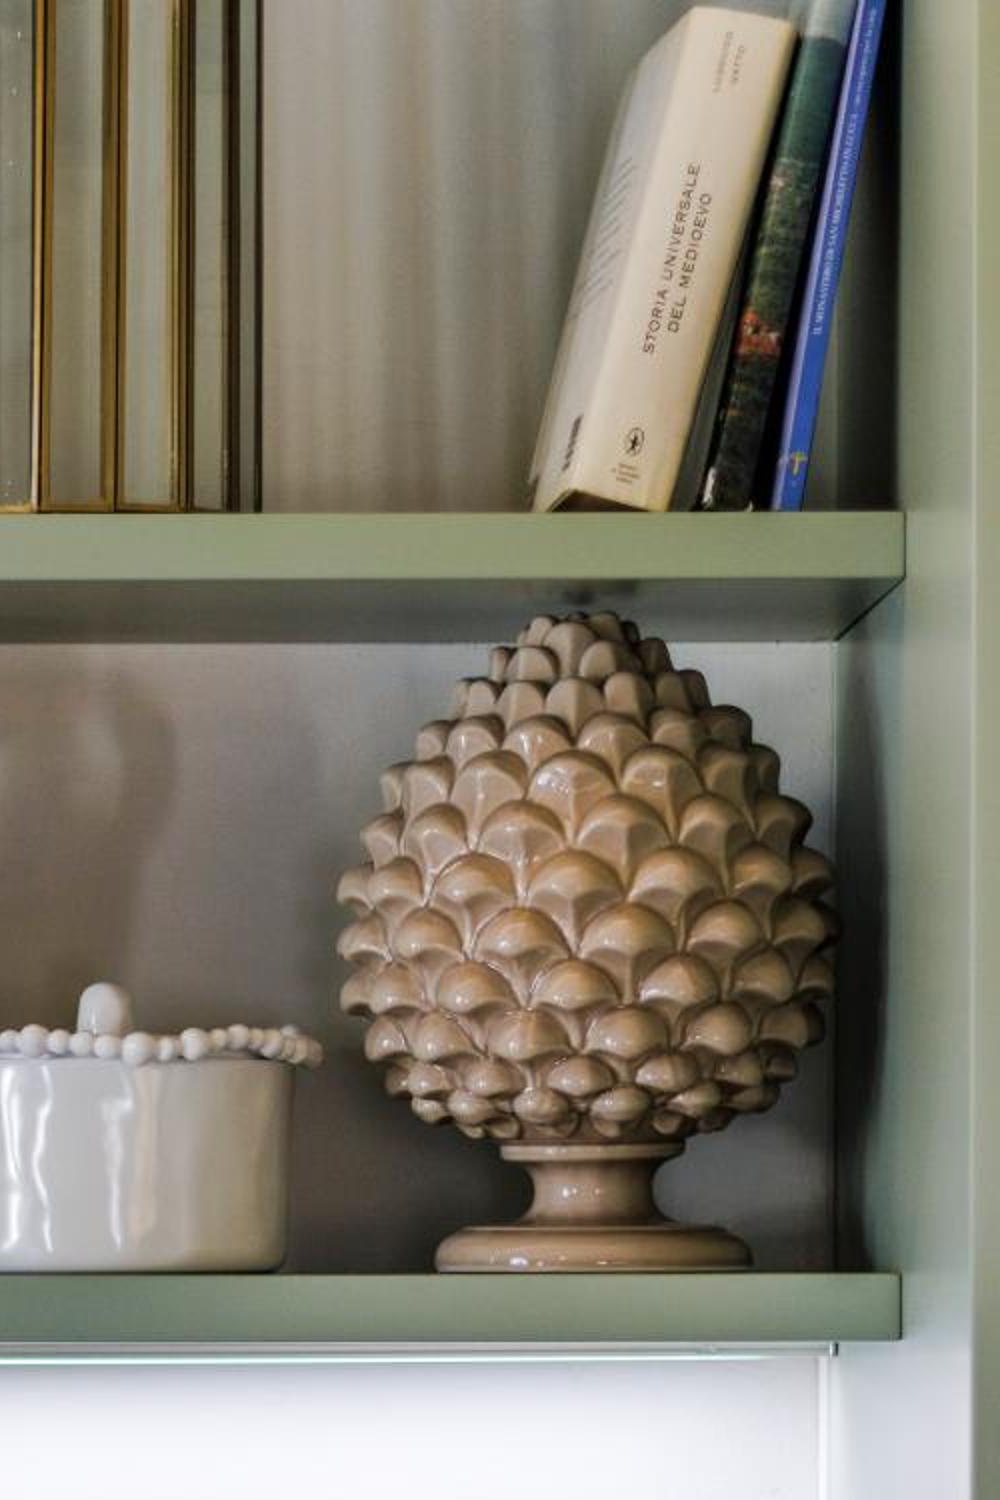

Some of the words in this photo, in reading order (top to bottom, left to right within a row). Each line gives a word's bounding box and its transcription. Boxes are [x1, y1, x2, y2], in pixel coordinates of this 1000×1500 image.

[643, 289, 668, 353] STORIA
[662, 164, 700, 280] UNIVERSALE
[666, 296, 687, 334] DEL
[679, 192, 711, 288] MEDIOEVO
